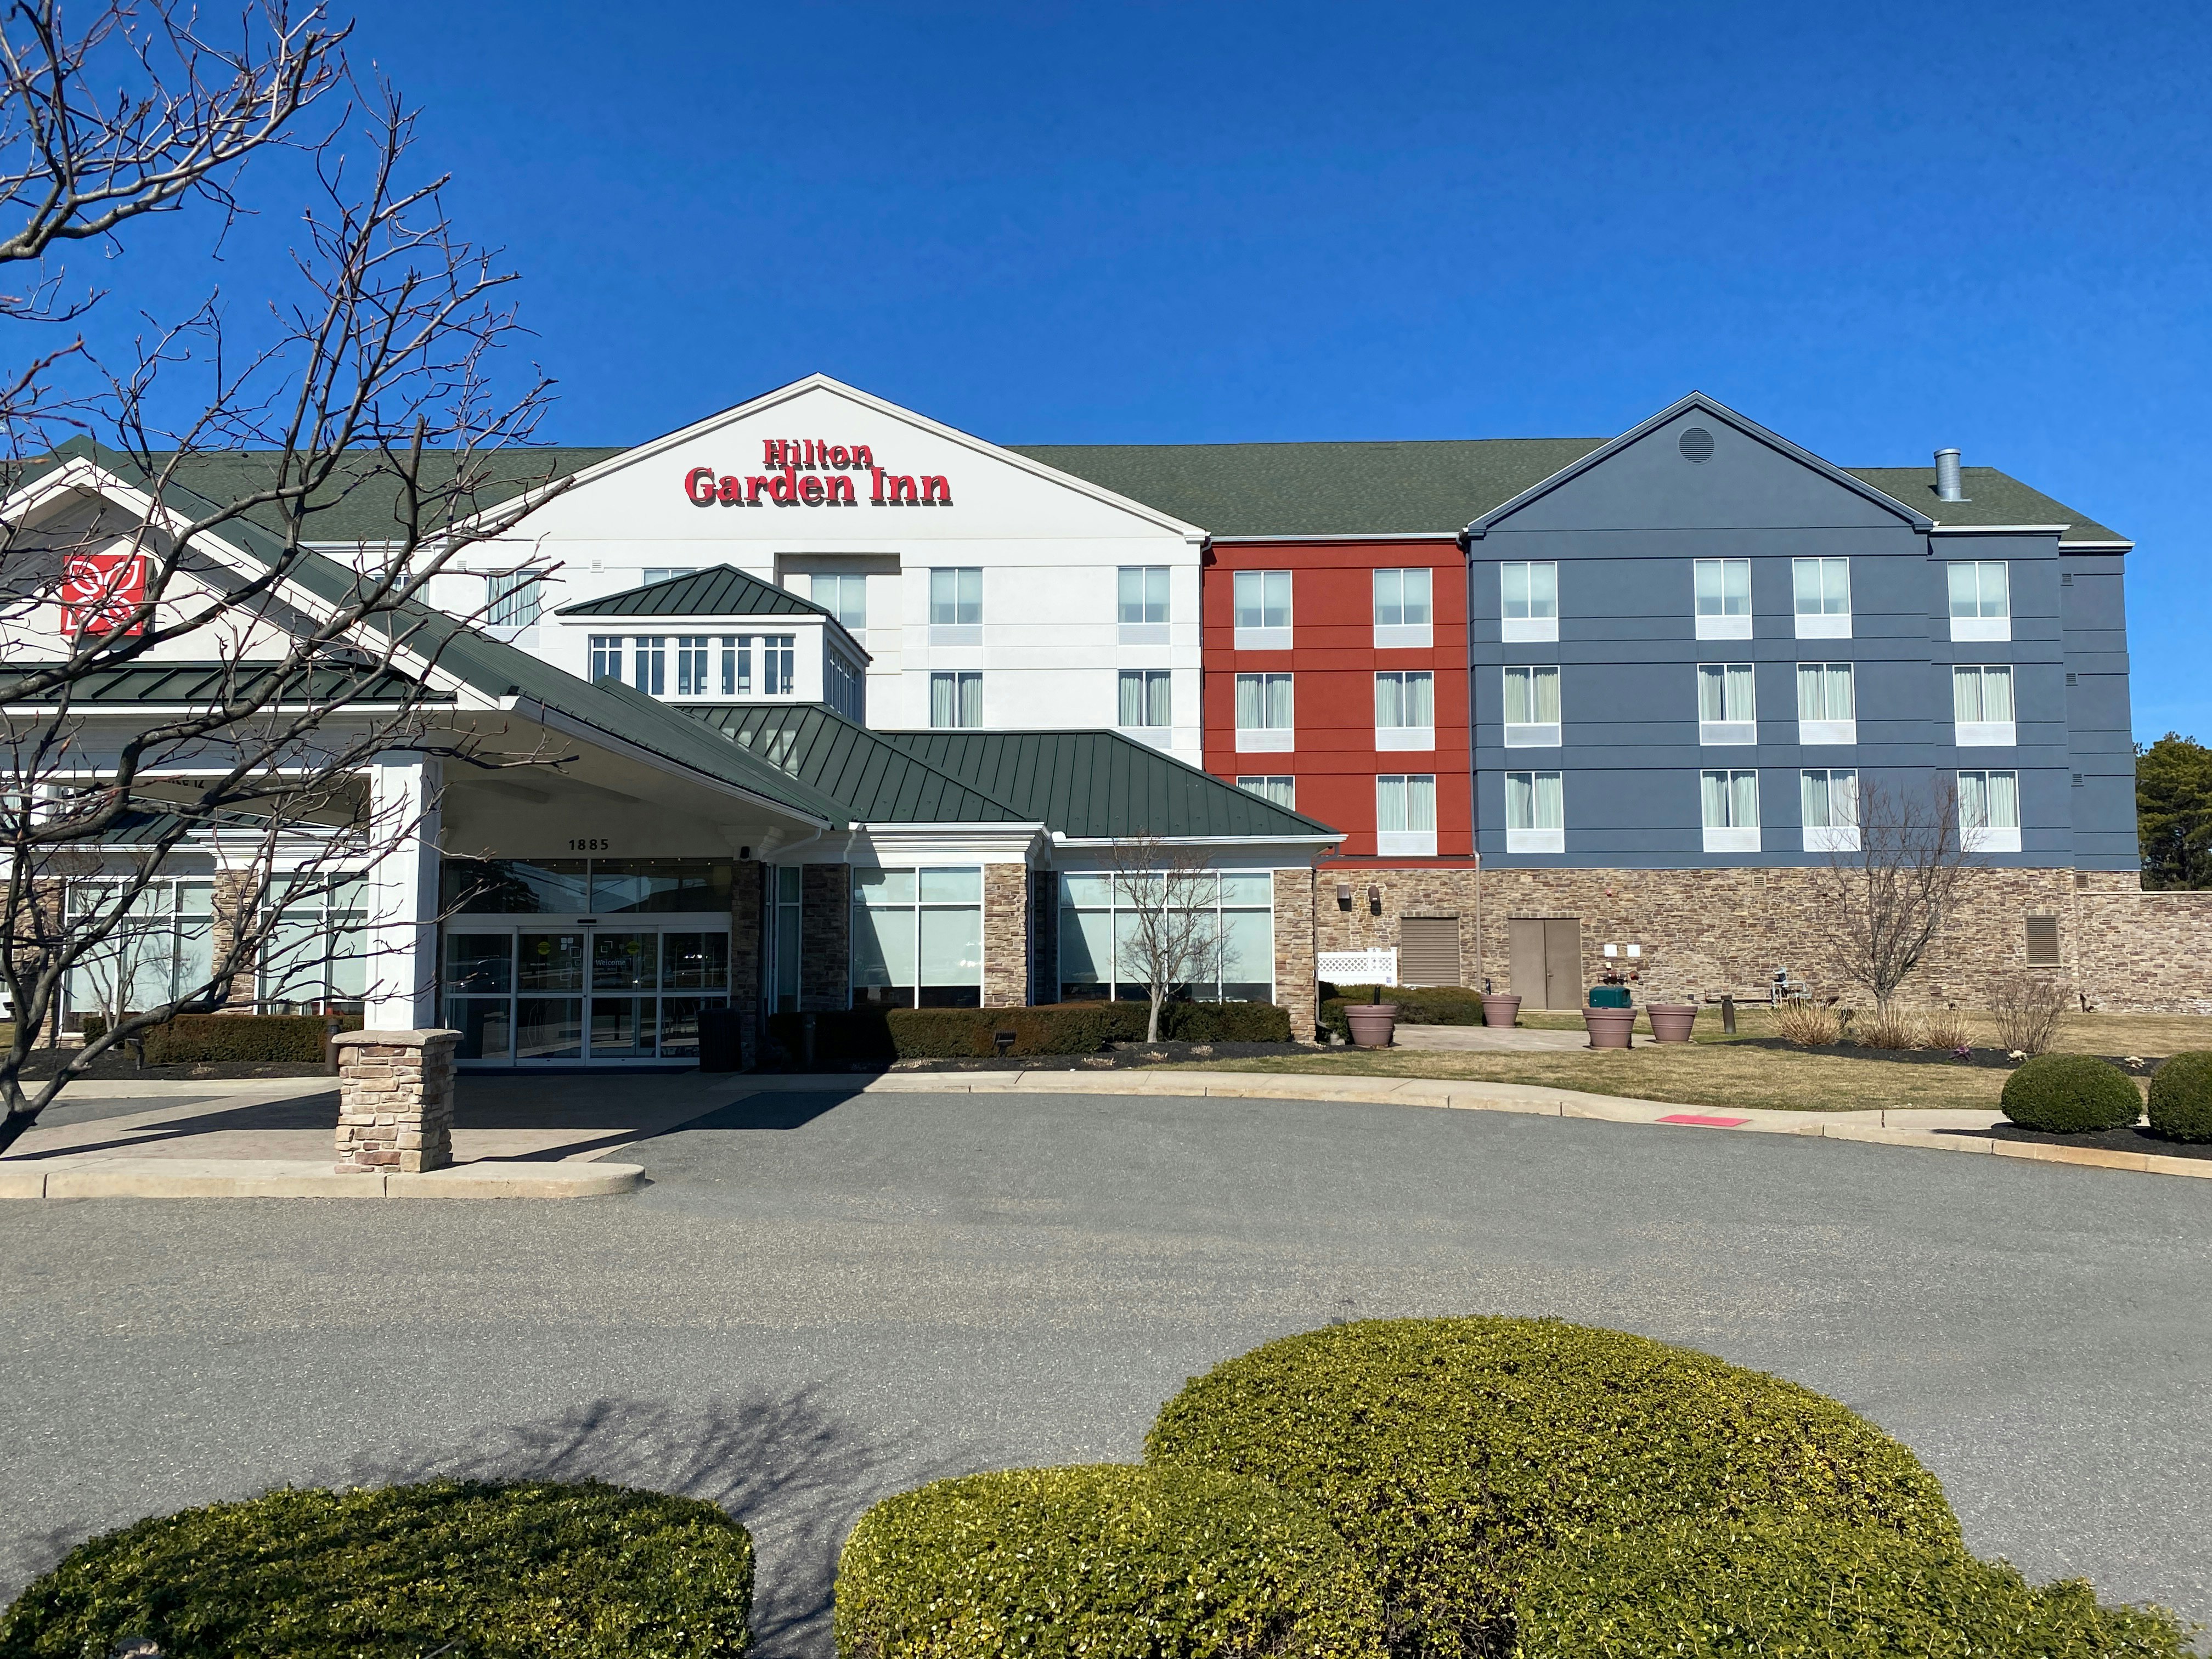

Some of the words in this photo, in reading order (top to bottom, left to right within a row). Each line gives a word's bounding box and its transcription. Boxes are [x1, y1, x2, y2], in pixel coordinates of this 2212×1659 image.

[762, 439, 873, 465] Hilton
[685, 466, 855, 501] Garden
[869, 466, 951, 501] Inn
[568, 839, 608, 850] 1885
